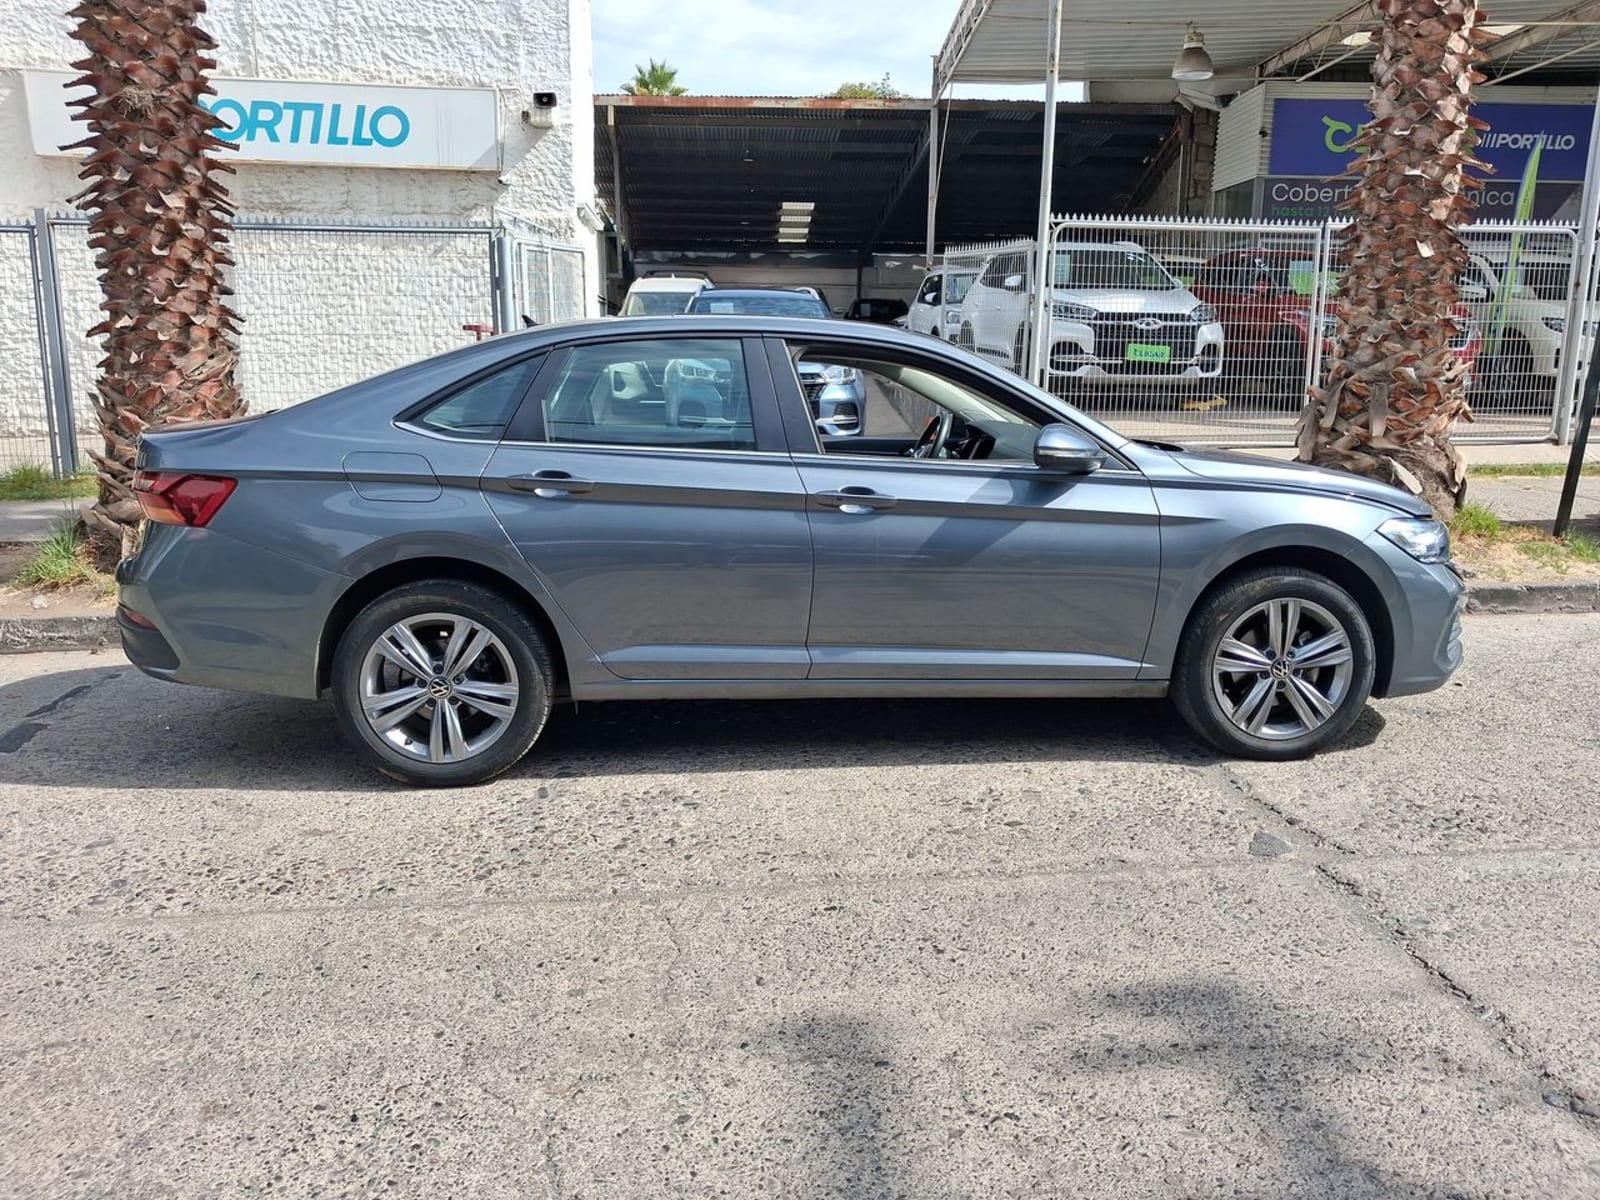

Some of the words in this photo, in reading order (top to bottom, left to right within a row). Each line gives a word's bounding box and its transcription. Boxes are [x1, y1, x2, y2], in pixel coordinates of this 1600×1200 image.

[198, 98, 410, 147] ORTILLO
[1272, 183, 1353, 202] Cobert
[1466, 189, 1515, 206] nica
[1271, 204, 1314, 217] hasta
